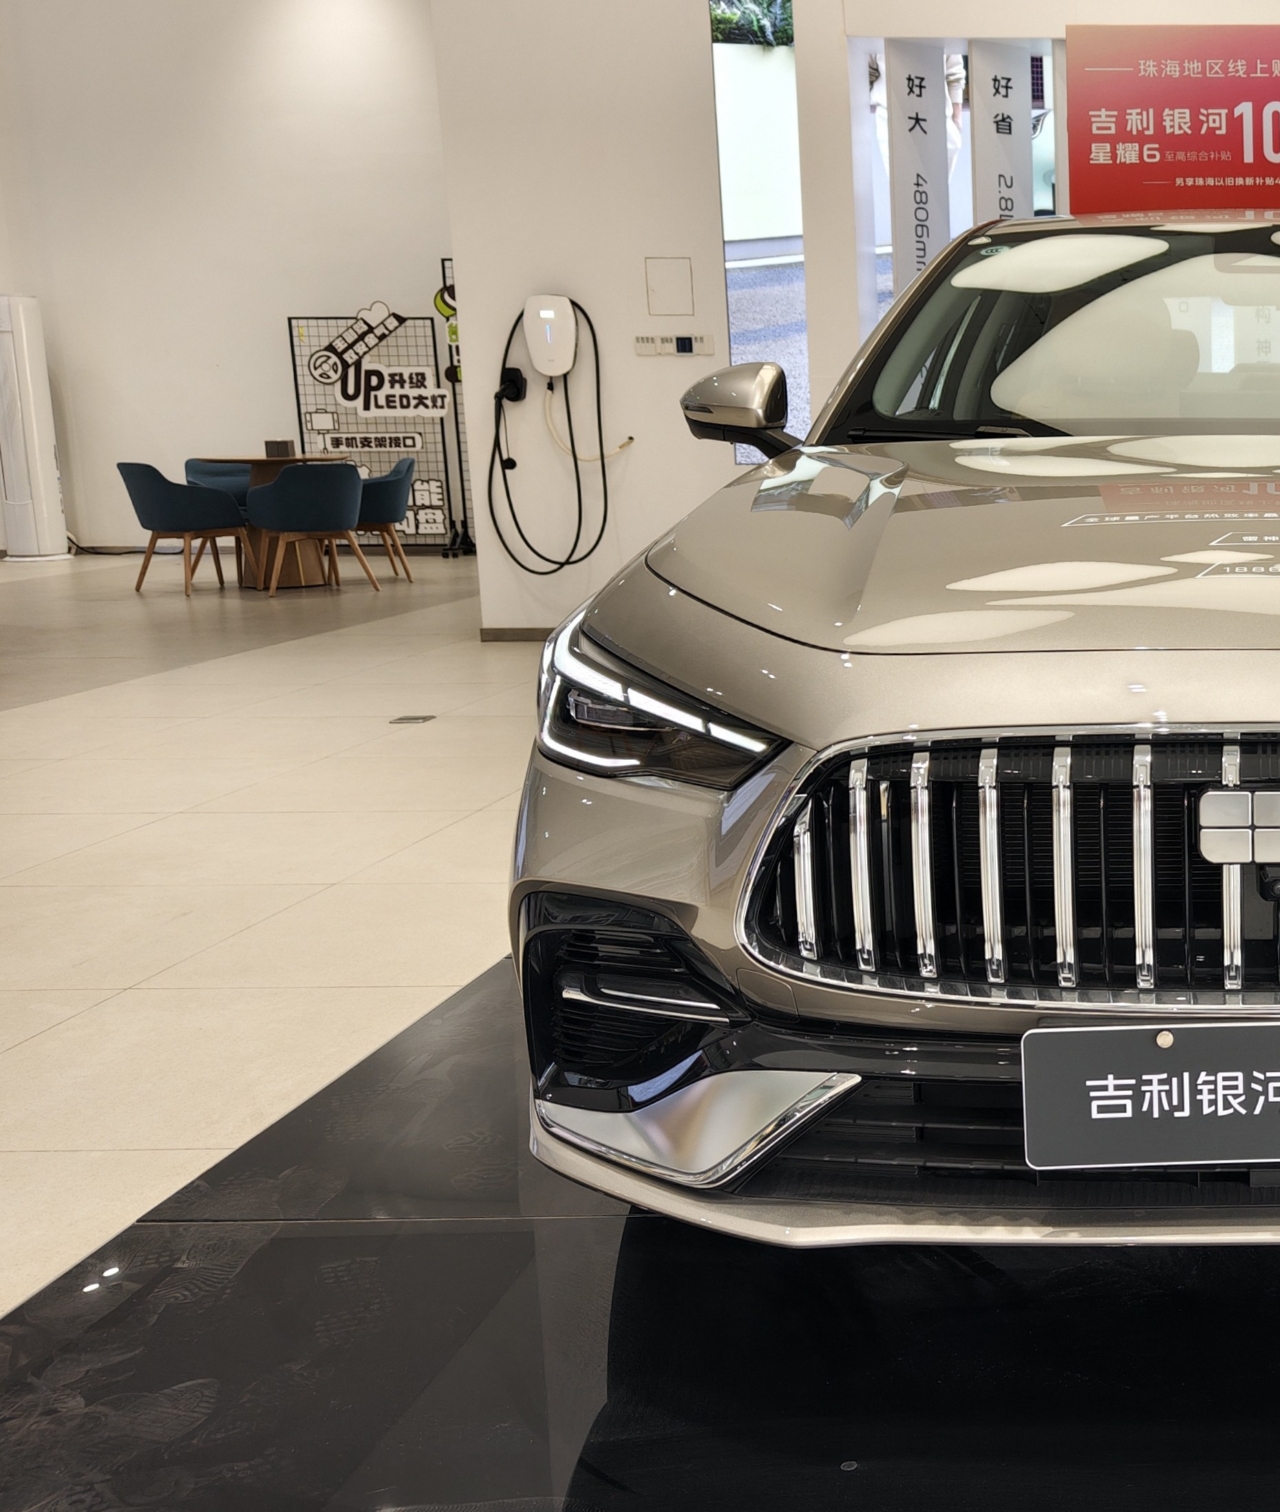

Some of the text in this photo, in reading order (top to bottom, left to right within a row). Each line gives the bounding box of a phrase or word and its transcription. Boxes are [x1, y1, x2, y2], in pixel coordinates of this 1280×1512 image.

[1088, 108, 1228, 135] 吉利银河
[1089, 142, 1232, 165] 星耀6 至高综合补贴
[341, 357, 428, 411] UP 升级
[373, 394, 447, 410] LED大灯
[330, 436, 416, 449] 手机支架接口
